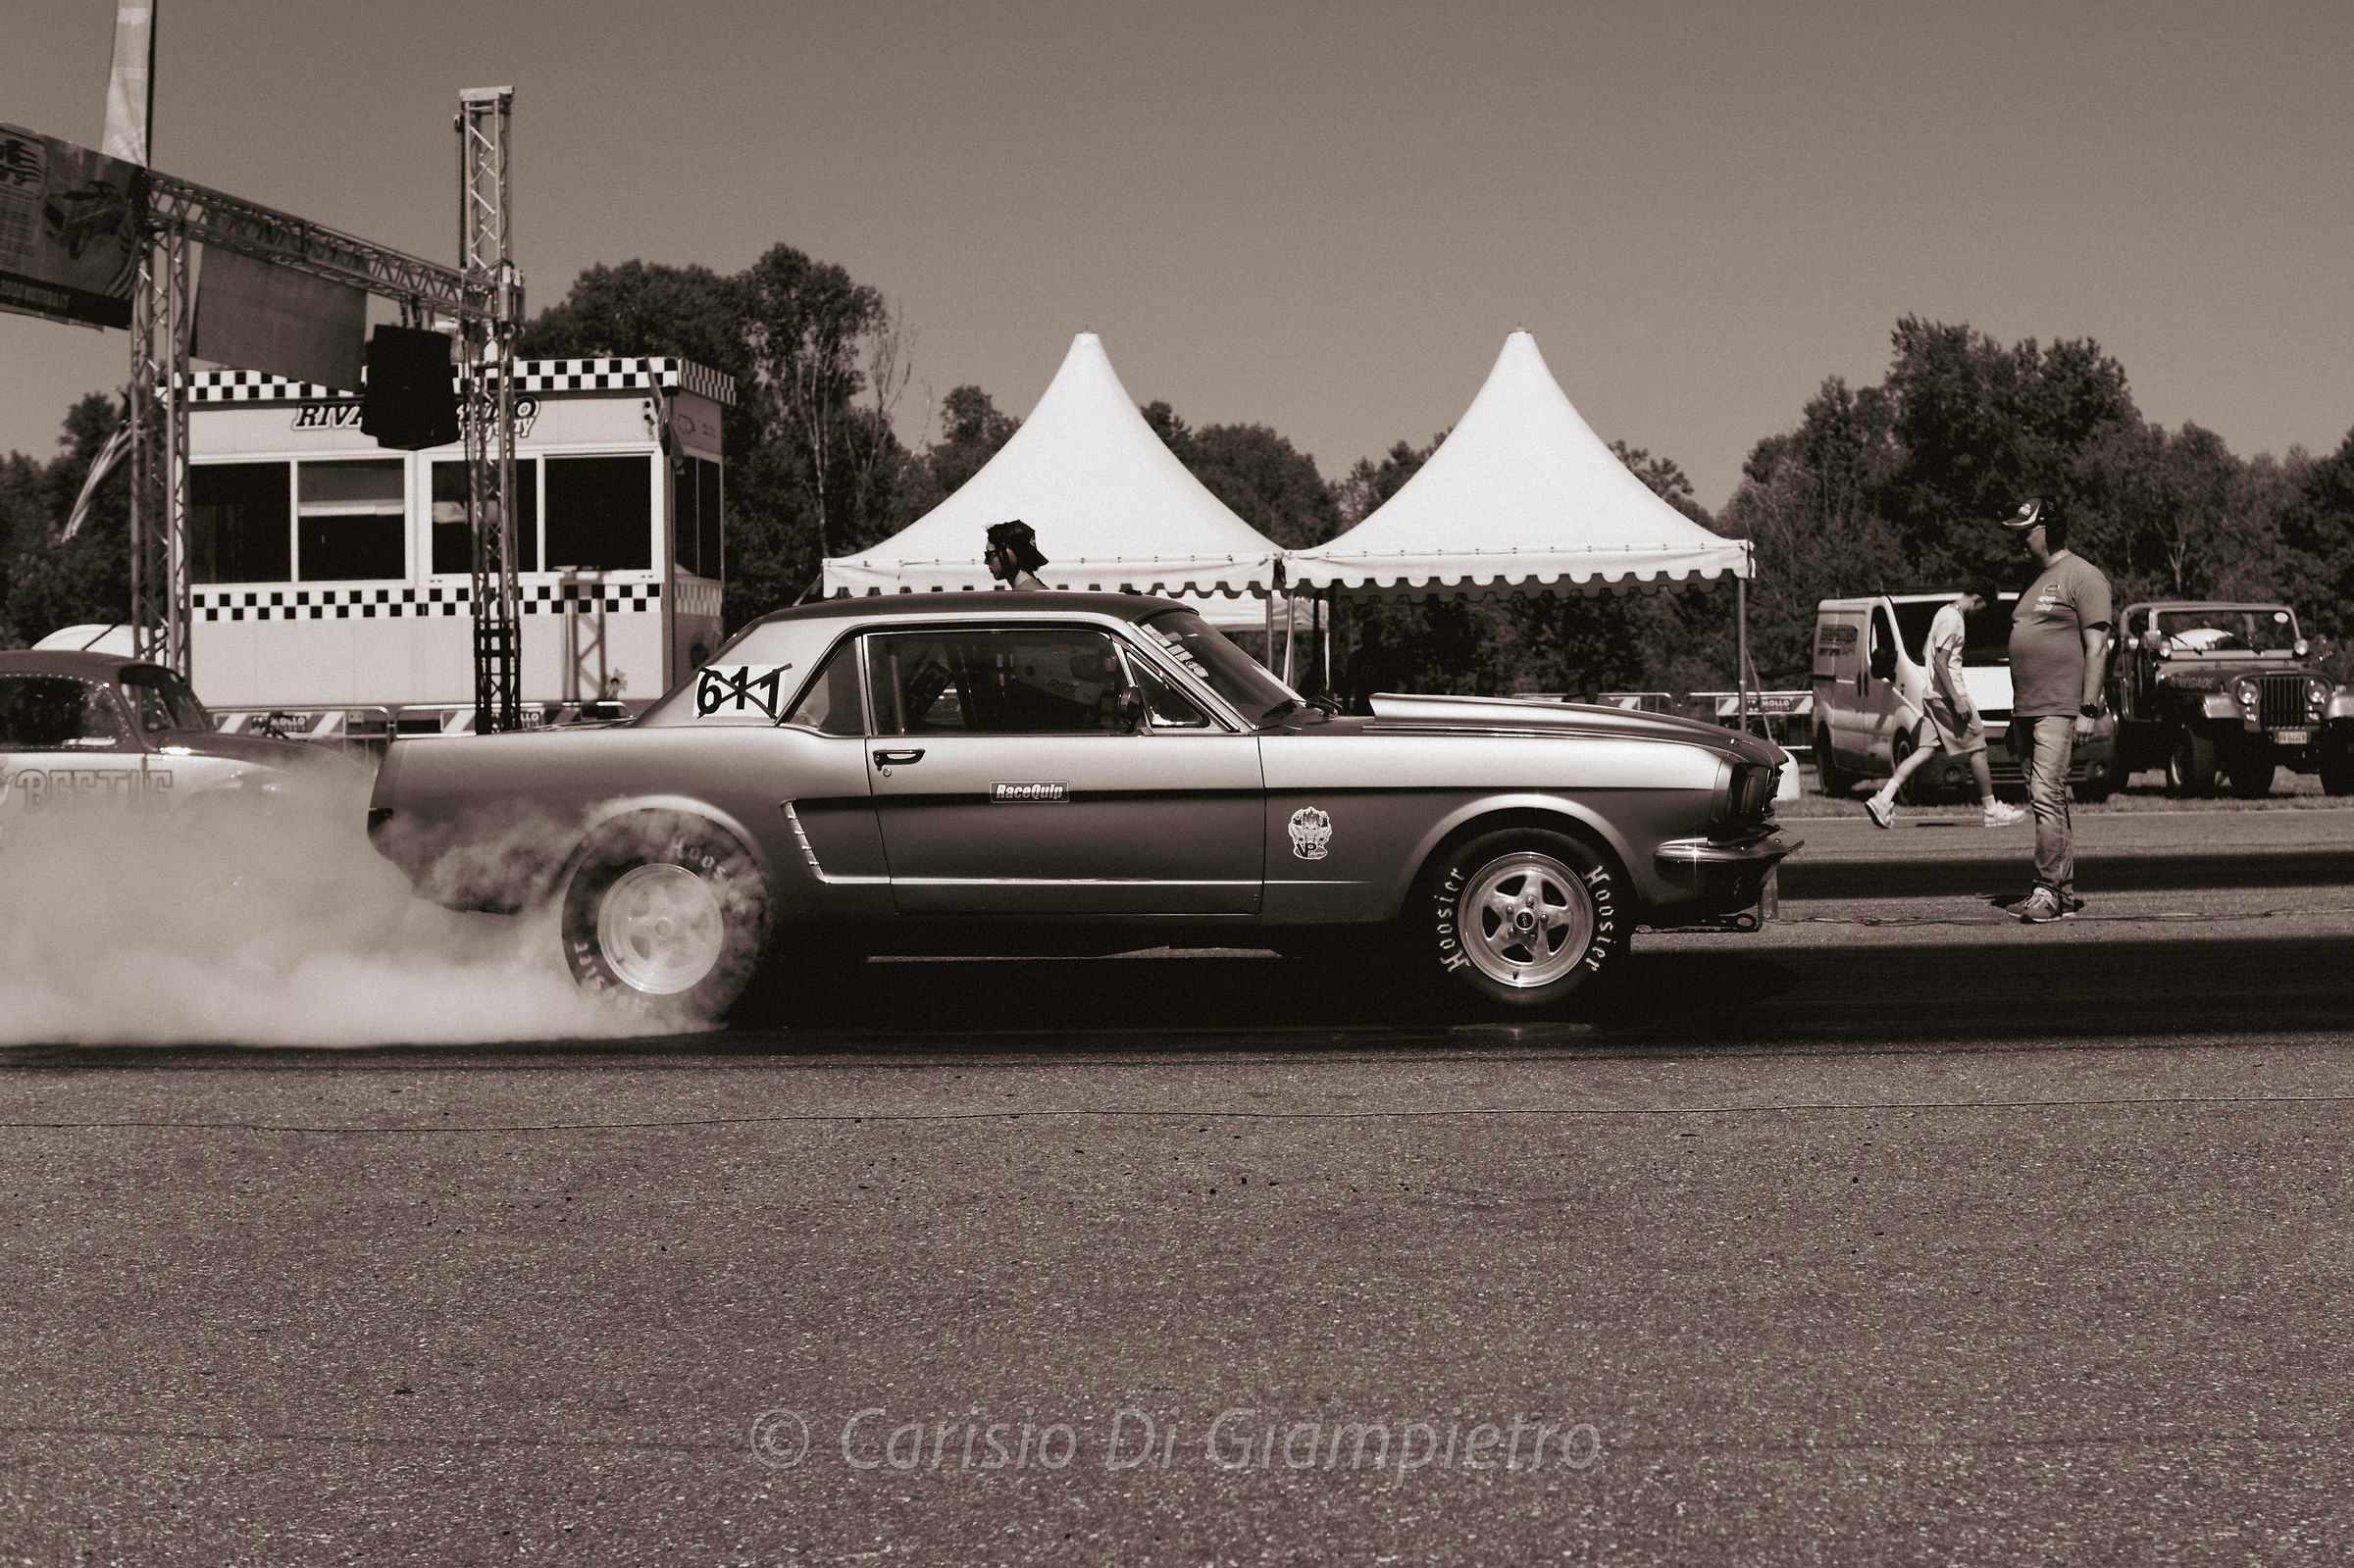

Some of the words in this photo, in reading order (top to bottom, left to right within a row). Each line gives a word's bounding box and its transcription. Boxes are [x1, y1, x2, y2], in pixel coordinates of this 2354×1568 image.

[697, 667, 781, 715] 611
[996, 784, 1063, 800] RaceQuip
[1296, 842, 1317, 858] VP
[1433, 867, 1471, 973] Hoosier
[1581, 865, 1617, 972] Hoosier
